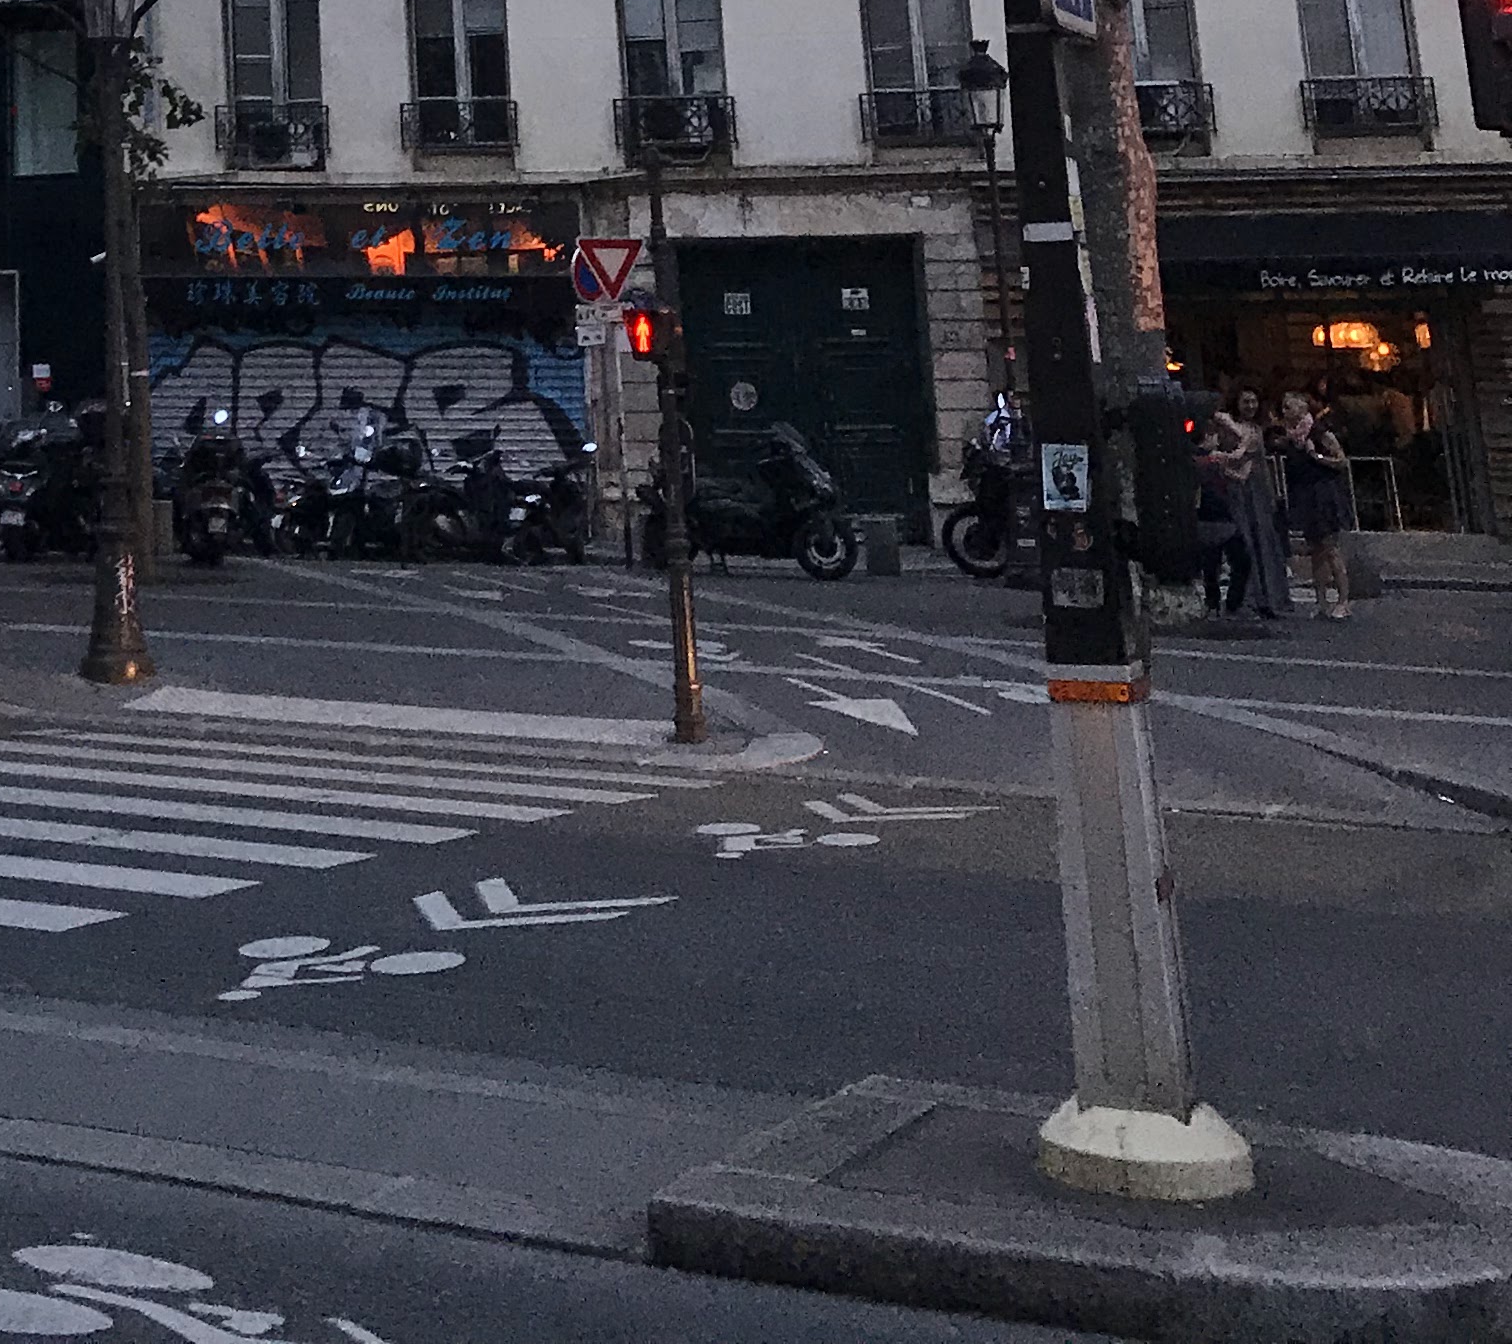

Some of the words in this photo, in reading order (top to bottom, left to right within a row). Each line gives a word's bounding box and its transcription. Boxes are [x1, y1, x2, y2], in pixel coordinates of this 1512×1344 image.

[195, 217, 306, 254] Belle
[435, 215, 512, 251] Zen
[1483, 268, 1512, 282] mo
